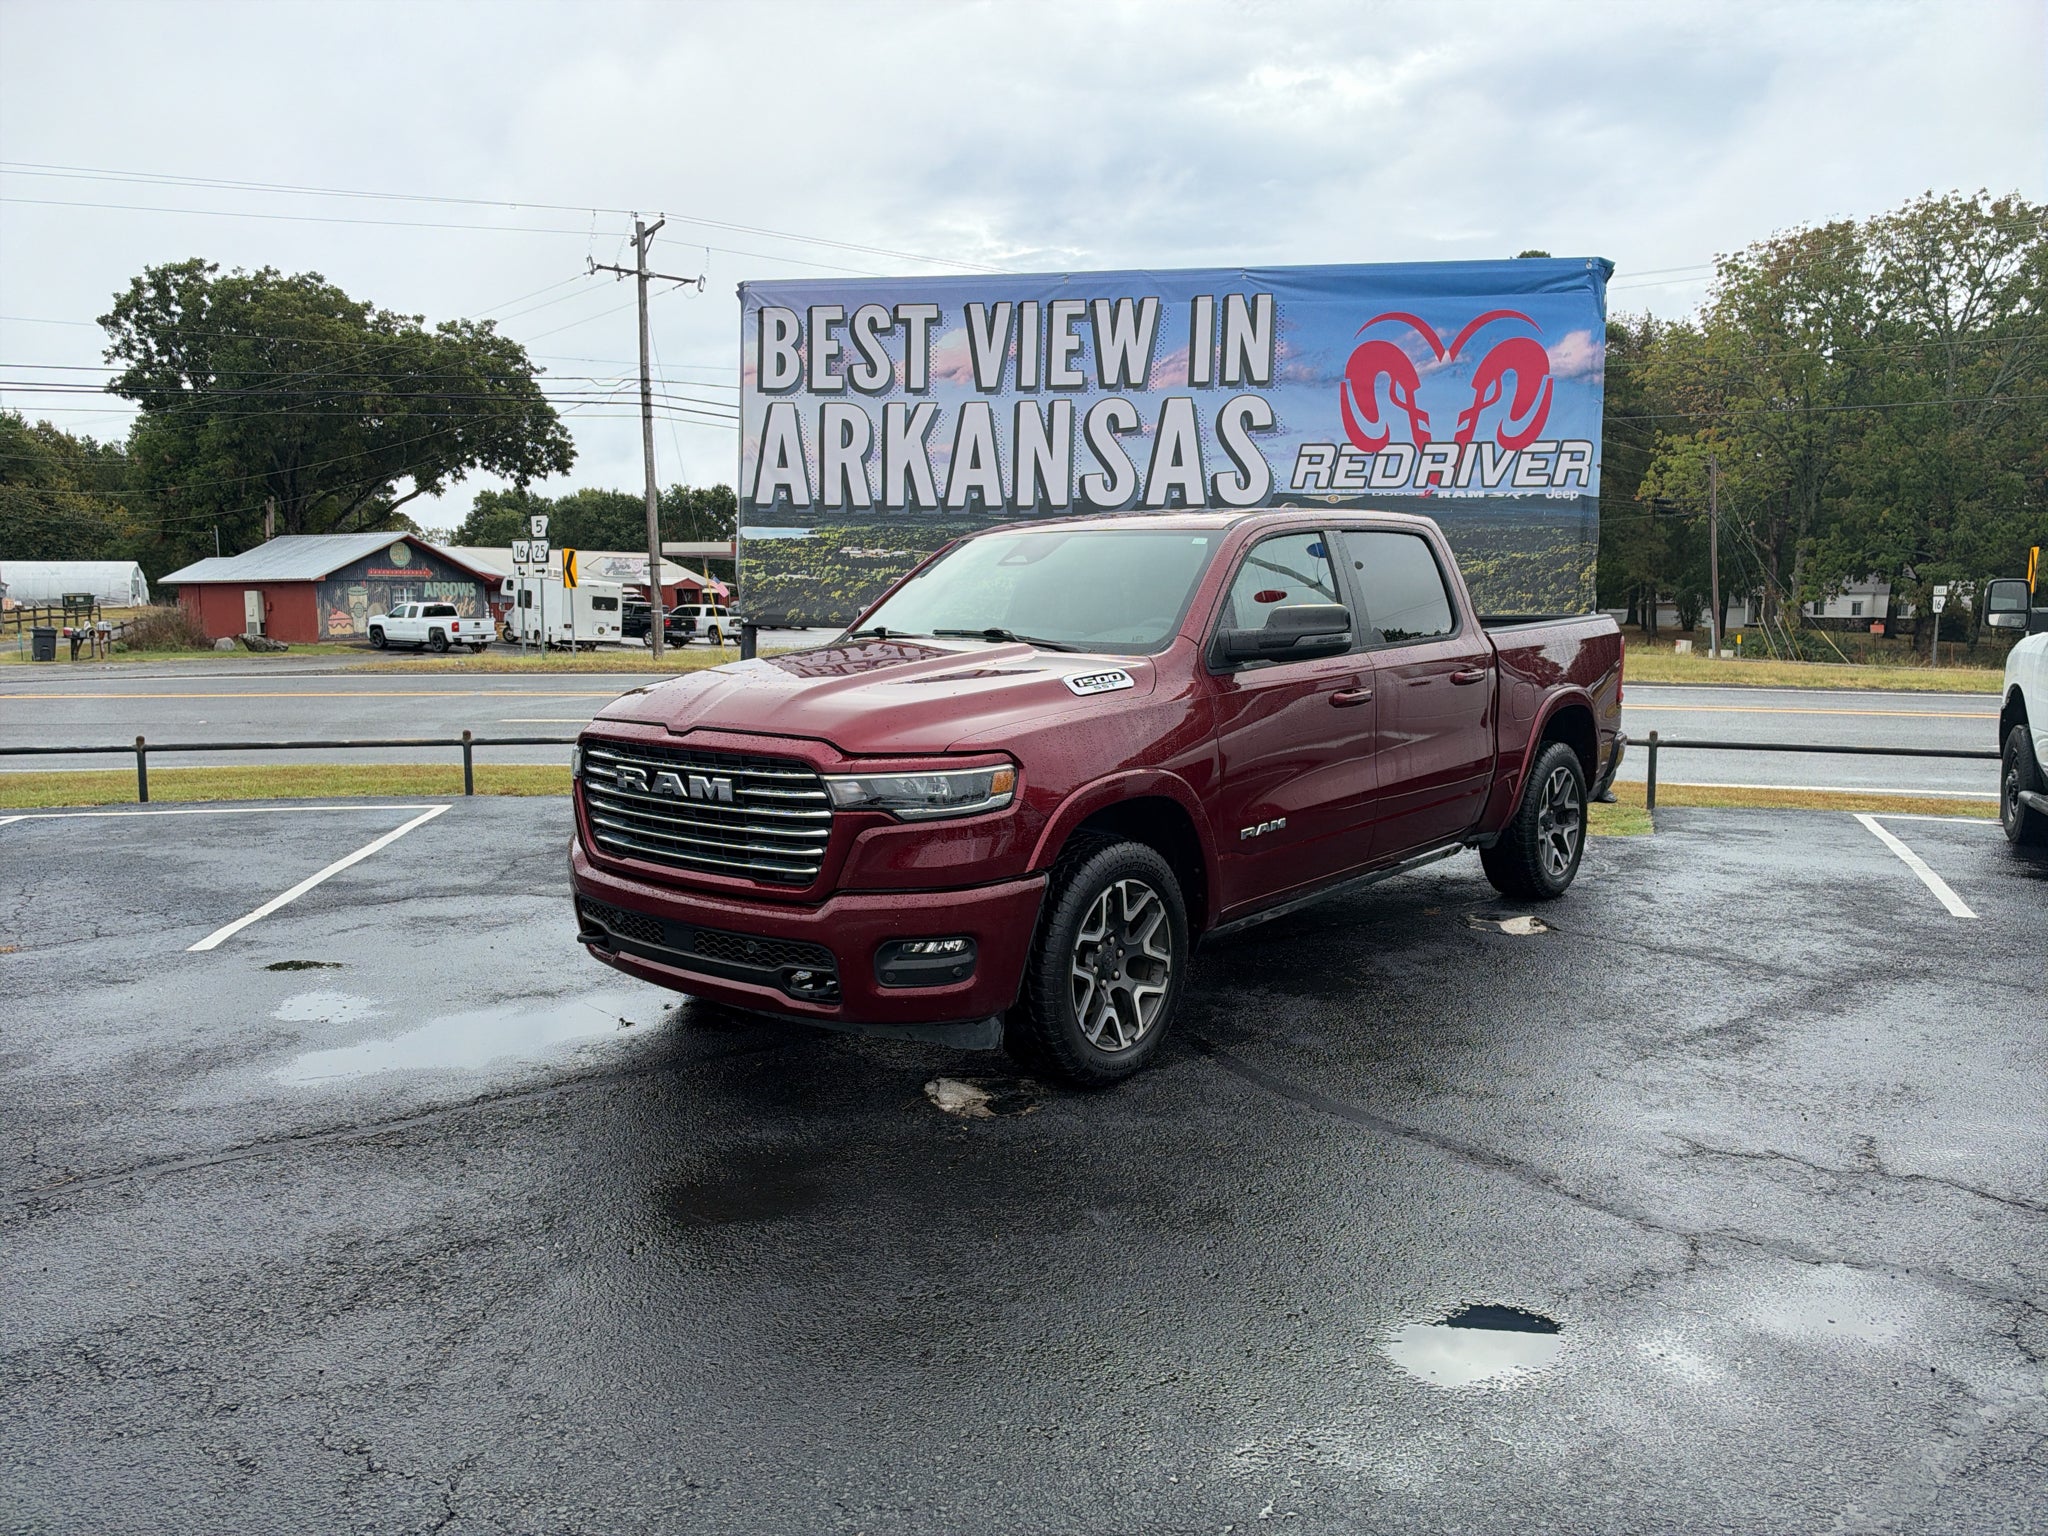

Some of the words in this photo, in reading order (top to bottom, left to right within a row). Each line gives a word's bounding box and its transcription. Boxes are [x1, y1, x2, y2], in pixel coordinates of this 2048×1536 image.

[757, 303, 939, 397] BEST
[963, 296, 1161, 393] VIEW
[1187, 293, 1274, 389] IN
[753, 394, 1276, 511] ARKANSAS
[1290, 440, 1594, 489] REDRIVER
[1437, 490, 1485, 499] RAM
[1545, 488, 1579, 501] Jeep
[535, 519, 543, 534] 5
[516, 544, 526, 559] 16
[534, 544, 546, 559] 25
[423, 581, 476, 598] ARROWS
[1934, 599, 1942, 610] 16
[1073, 672, 1126, 688] 1500
[616, 754, 733, 802] RAM
[1241, 817, 1287, 841] RAM
